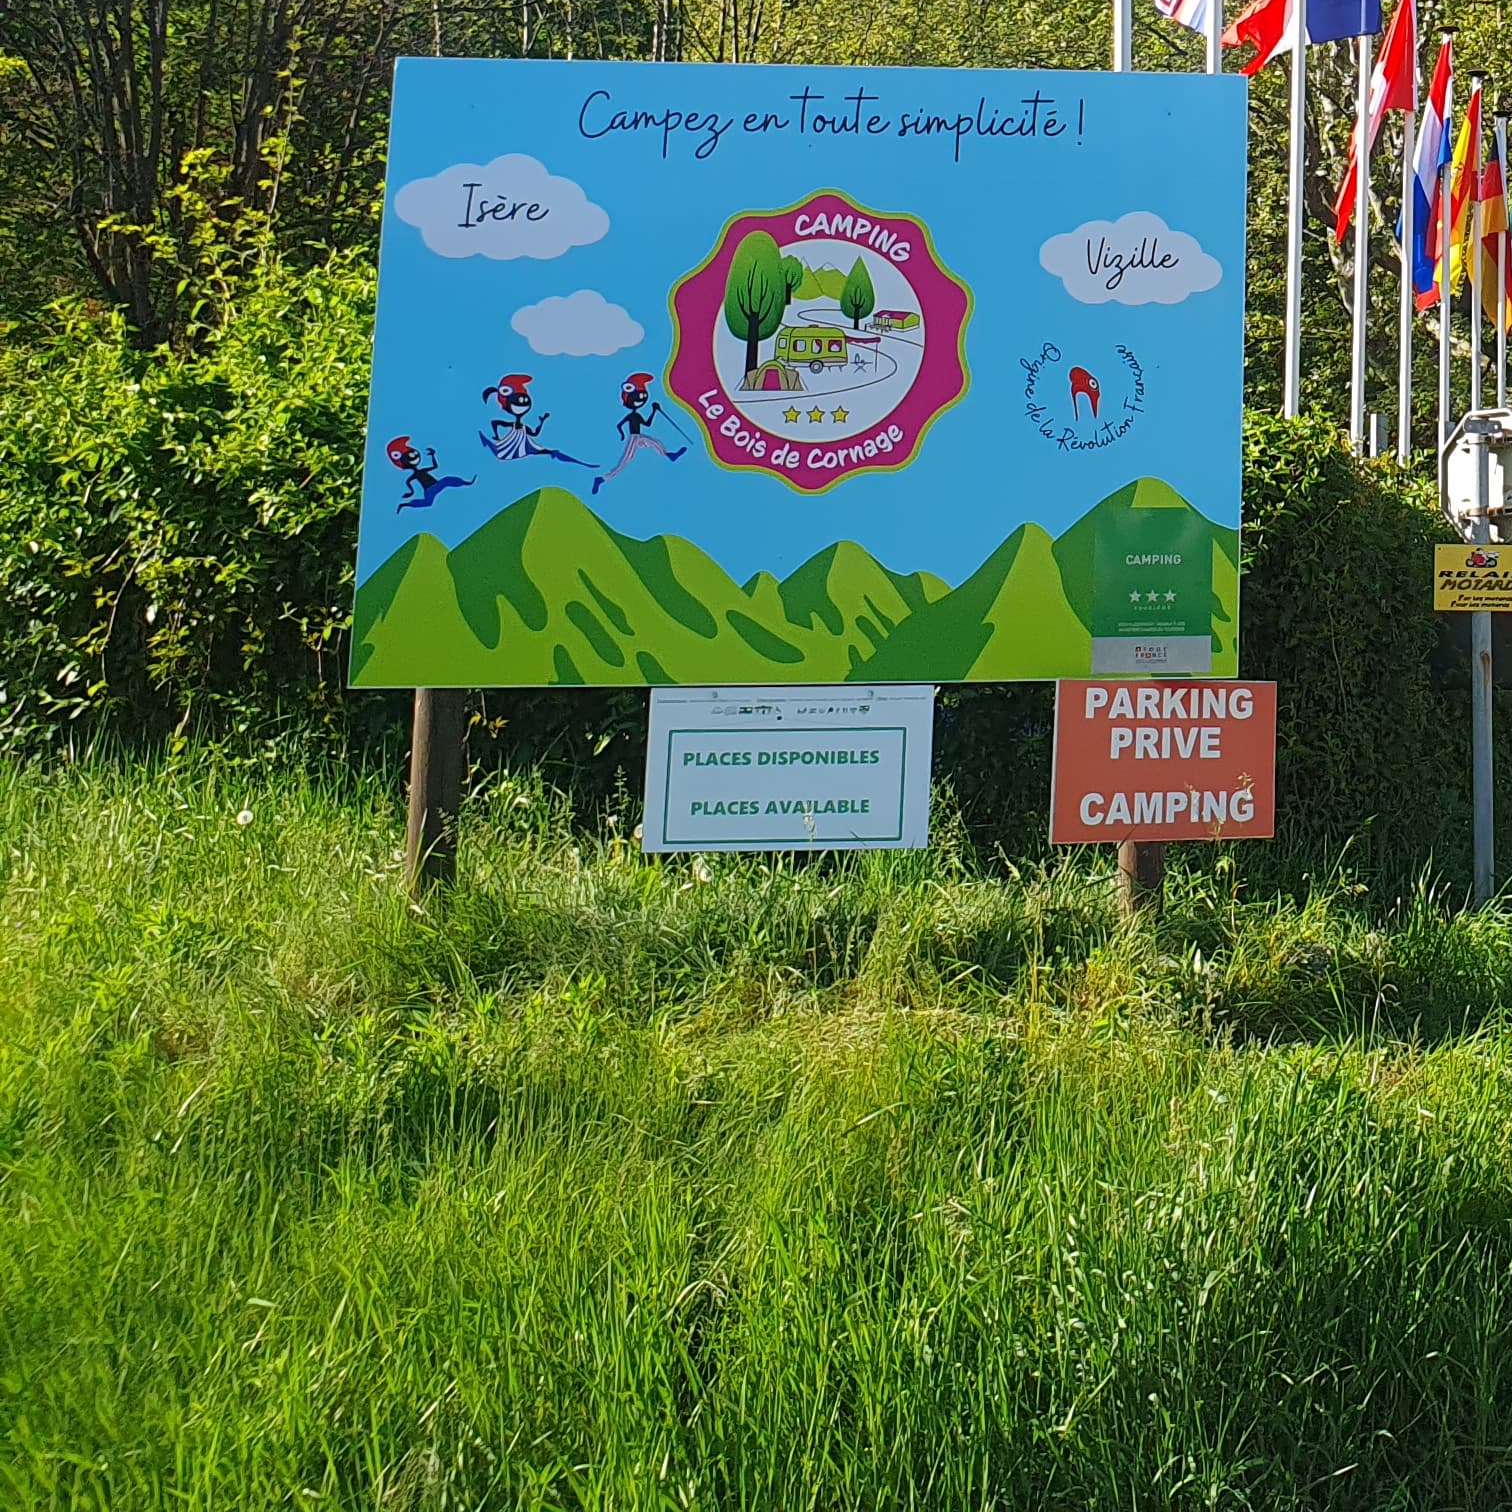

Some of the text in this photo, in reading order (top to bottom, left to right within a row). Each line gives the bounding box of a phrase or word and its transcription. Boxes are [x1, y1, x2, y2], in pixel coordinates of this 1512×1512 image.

[579, 90, 734, 159] Campez
[743, 110, 789, 135] en
[898, 90, 1067, 162] simplicité
[457, 183, 550, 228] Isère
[794, 212, 911, 263] CAMPING
[1087, 236, 1180, 291] Vizille
[1019, 342, 1061, 400] Origine
[698, 388, 904, 470] Le Bois de Cornage
[1024, 403, 1047, 423] de
[1039, 418, 1057, 439] la
[1056, 416, 1134, 452] Révolution
[1125, 554, 1182, 565] CAMPING
[1084, 687, 1254, 720] PARKING
[683, 749, 880, 767] PLACES DISPONIBLES
[1110, 726, 1222, 760] PRIVE
[690, 798, 871, 816] PLACES AVAILABLE
[1079, 790, 1255, 826] CAMPING
